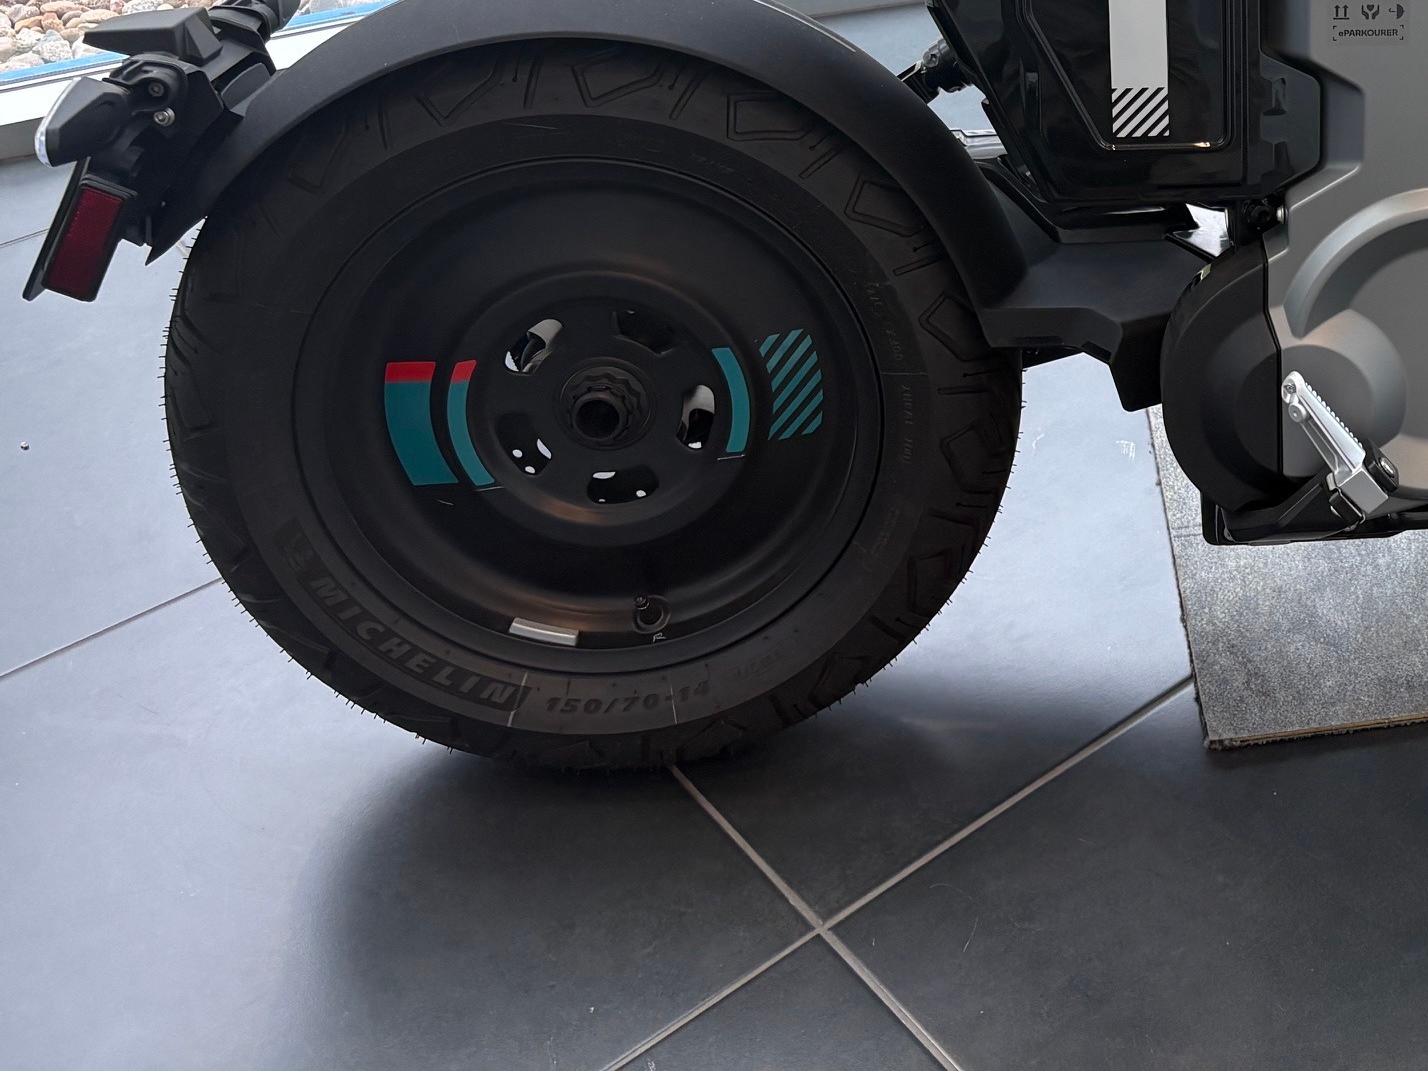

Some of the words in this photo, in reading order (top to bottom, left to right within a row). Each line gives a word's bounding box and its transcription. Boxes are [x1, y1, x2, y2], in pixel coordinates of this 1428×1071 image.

[1338, 28, 1399, 38] ePARKOURER
[308, 576, 518, 704] MICHELIN
[546, 679, 711, 714] 150/70-14
